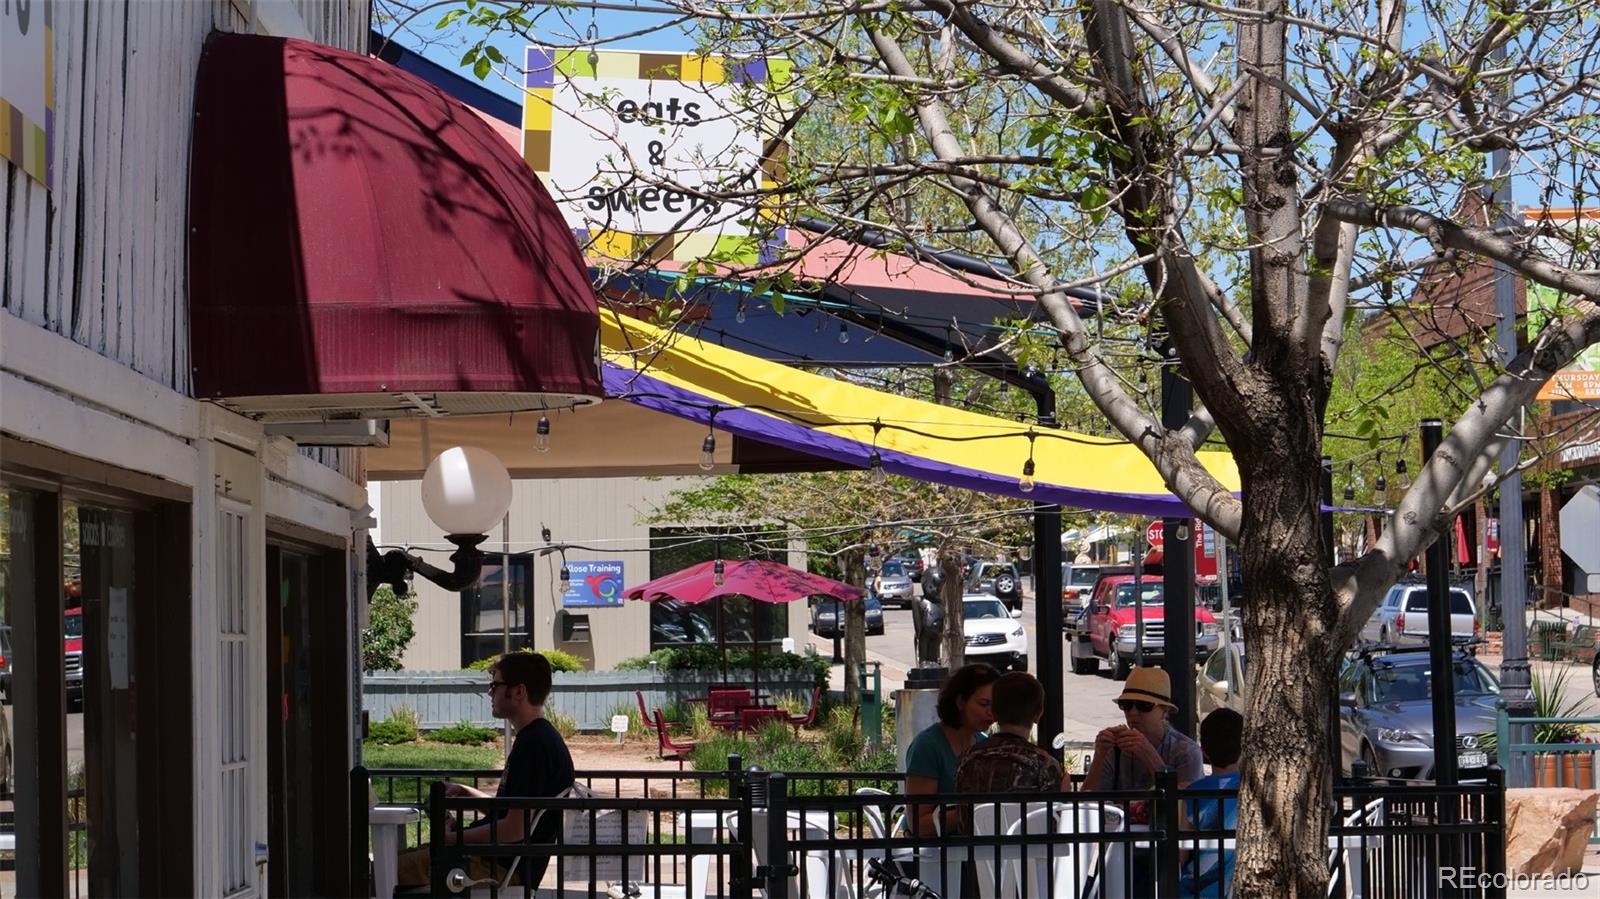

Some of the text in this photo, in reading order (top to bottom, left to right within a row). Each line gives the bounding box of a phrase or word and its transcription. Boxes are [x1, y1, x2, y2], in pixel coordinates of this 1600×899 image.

[616, 97, 702, 127] eats
[647, 140, 665, 167] &
[1149, 529, 1164, 540] STO
[588, 564, 621, 574] Training
